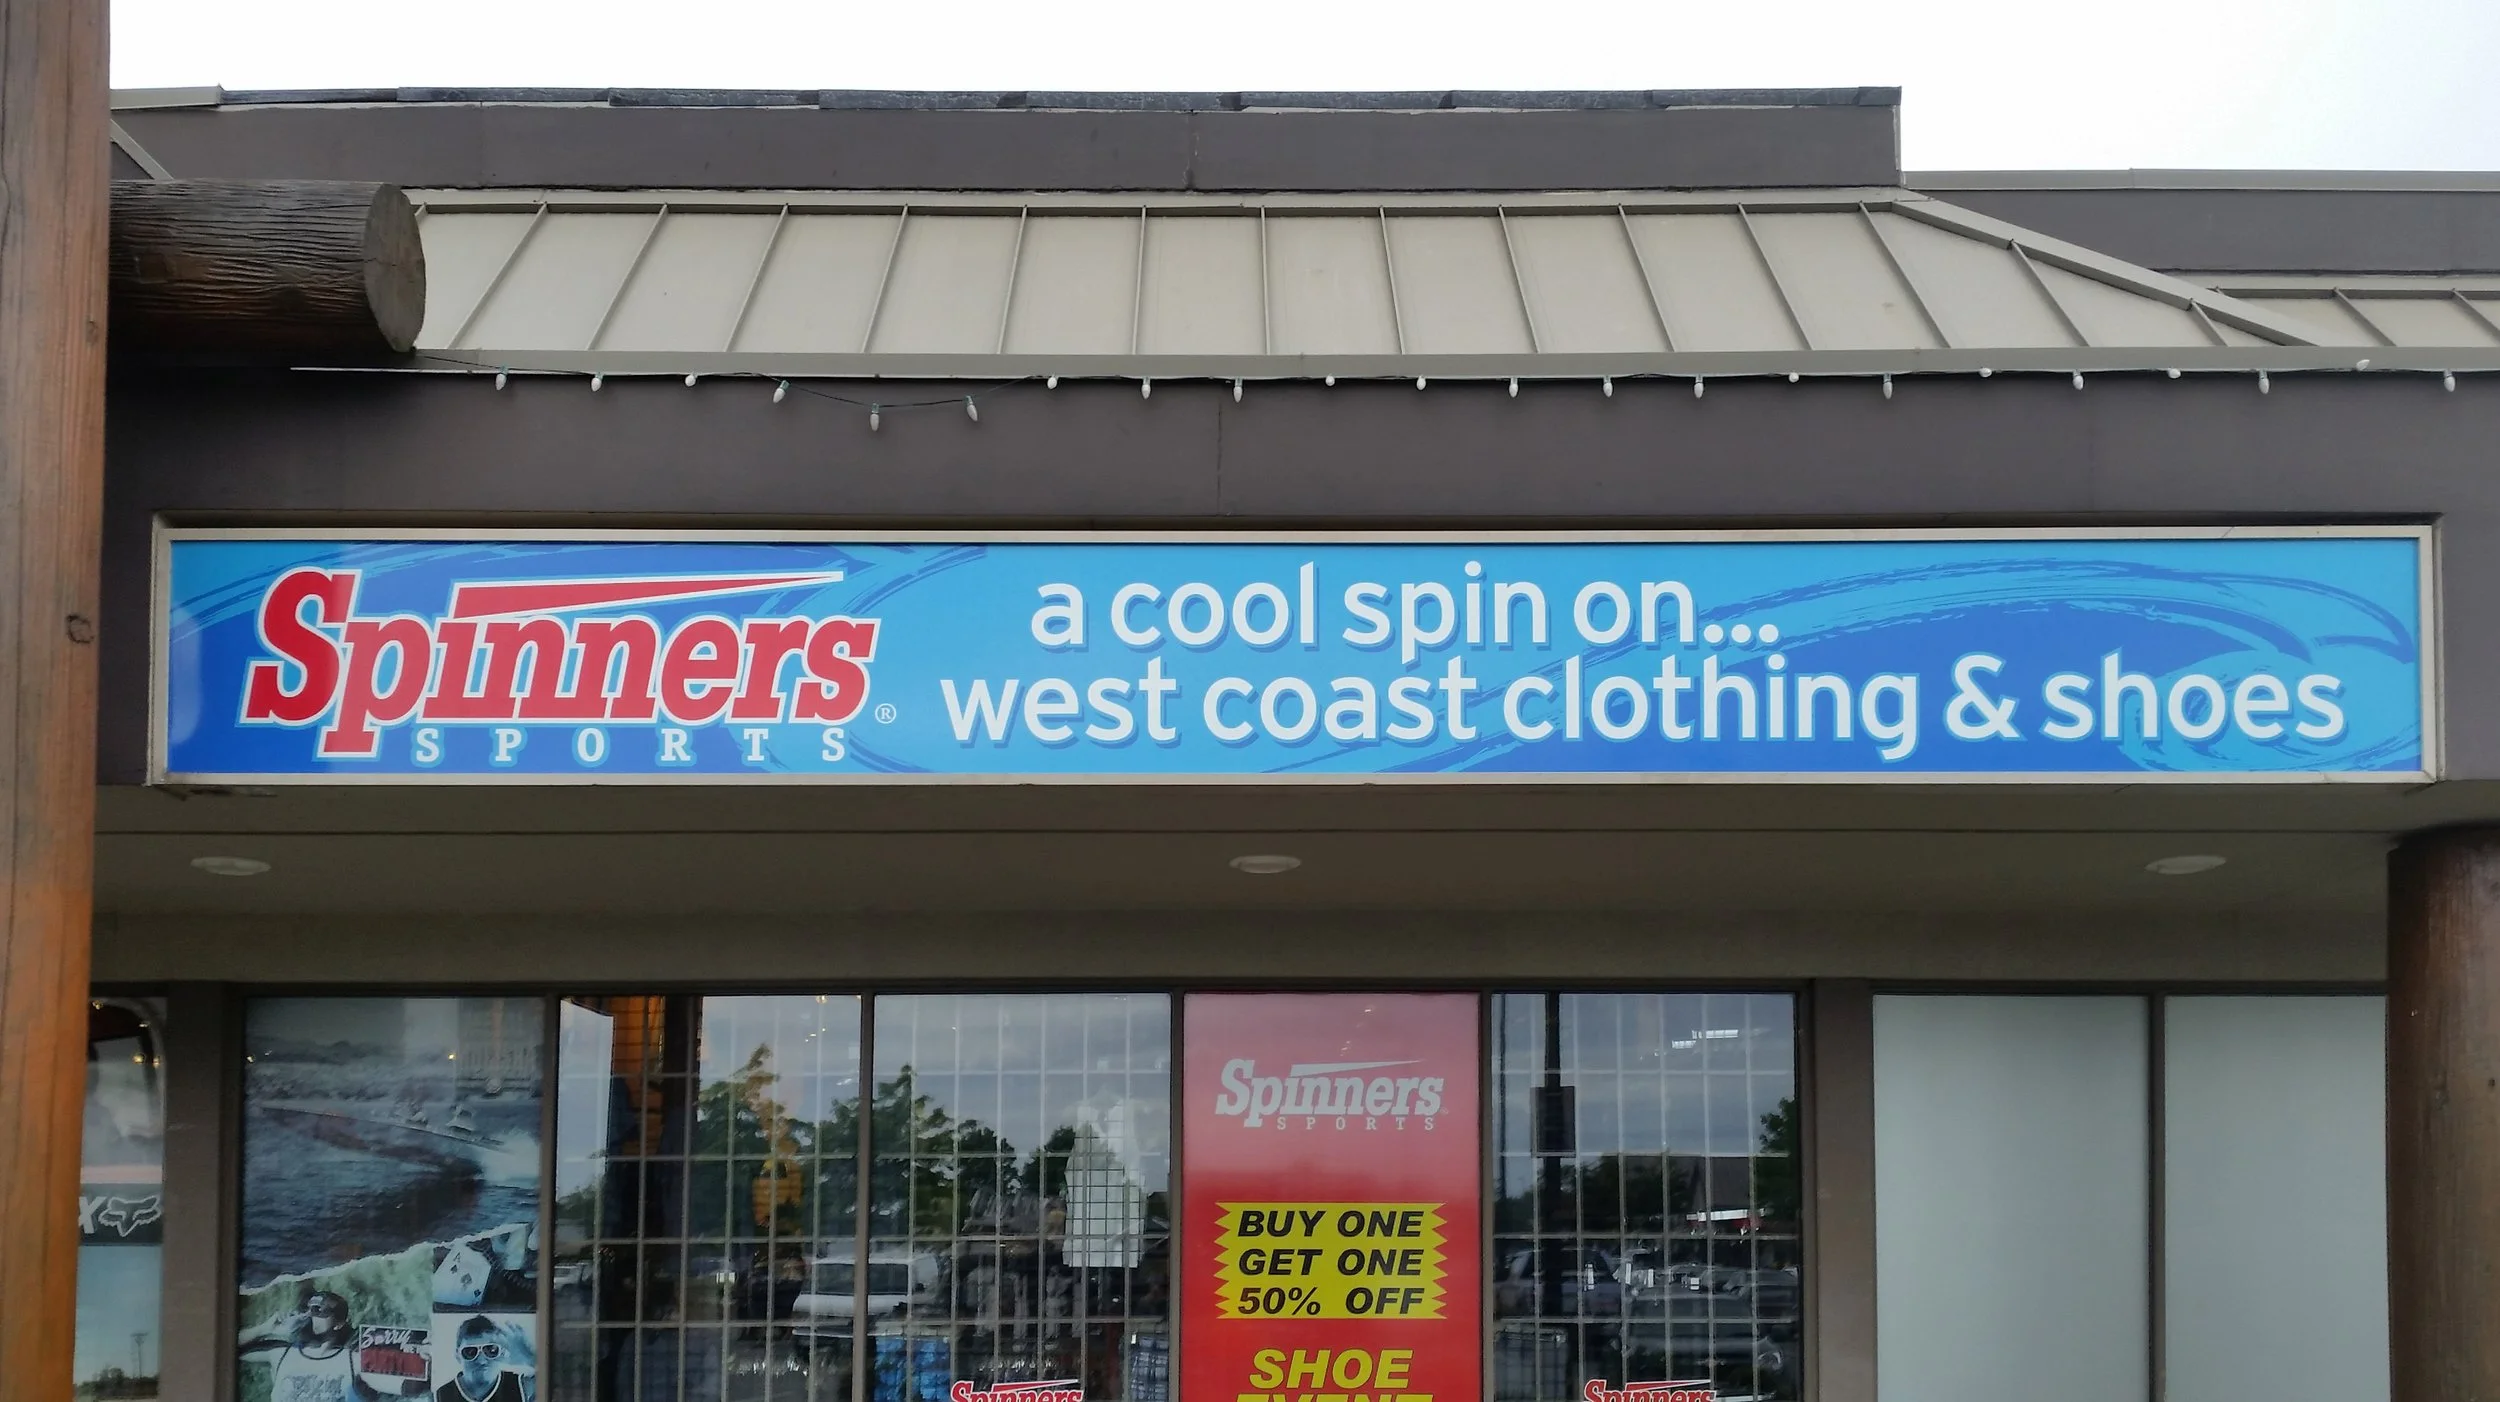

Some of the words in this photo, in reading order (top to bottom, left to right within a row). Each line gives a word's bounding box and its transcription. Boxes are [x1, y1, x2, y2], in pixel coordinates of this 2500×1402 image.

[1030, 580, 1085, 646] a
[1110, 561, 1315, 646] cool
[1342, 560, 1547, 664] spin
[1573, 580, 1779, 646] on...
[242, 566, 881, 758] Spinners
[940, 655, 1177, 742] west
[1203, 655, 1477, 742] coast
[1502, 654, 1917, 761] clothing
[1944, 653, 2021, 740] &
[2043, 648, 2346, 740] shoes
[416, 727, 846, 762] SPORTS
[1214, 1058, 1445, 1128] Spinners
[1276, 1116, 1434, 1131] SPORTS
[1238, 1210, 1327, 1237] BUY
[1337, 1210, 1425, 1237] ONE
[1239, 1248, 1323, 1276] GET
[1337, 1248, 1425, 1276] ONE
[1238, 1287, 1321, 1315] 50%
[1345, 1287, 1425, 1315] OFF
[1249, 1347, 1414, 1389] SHOE
